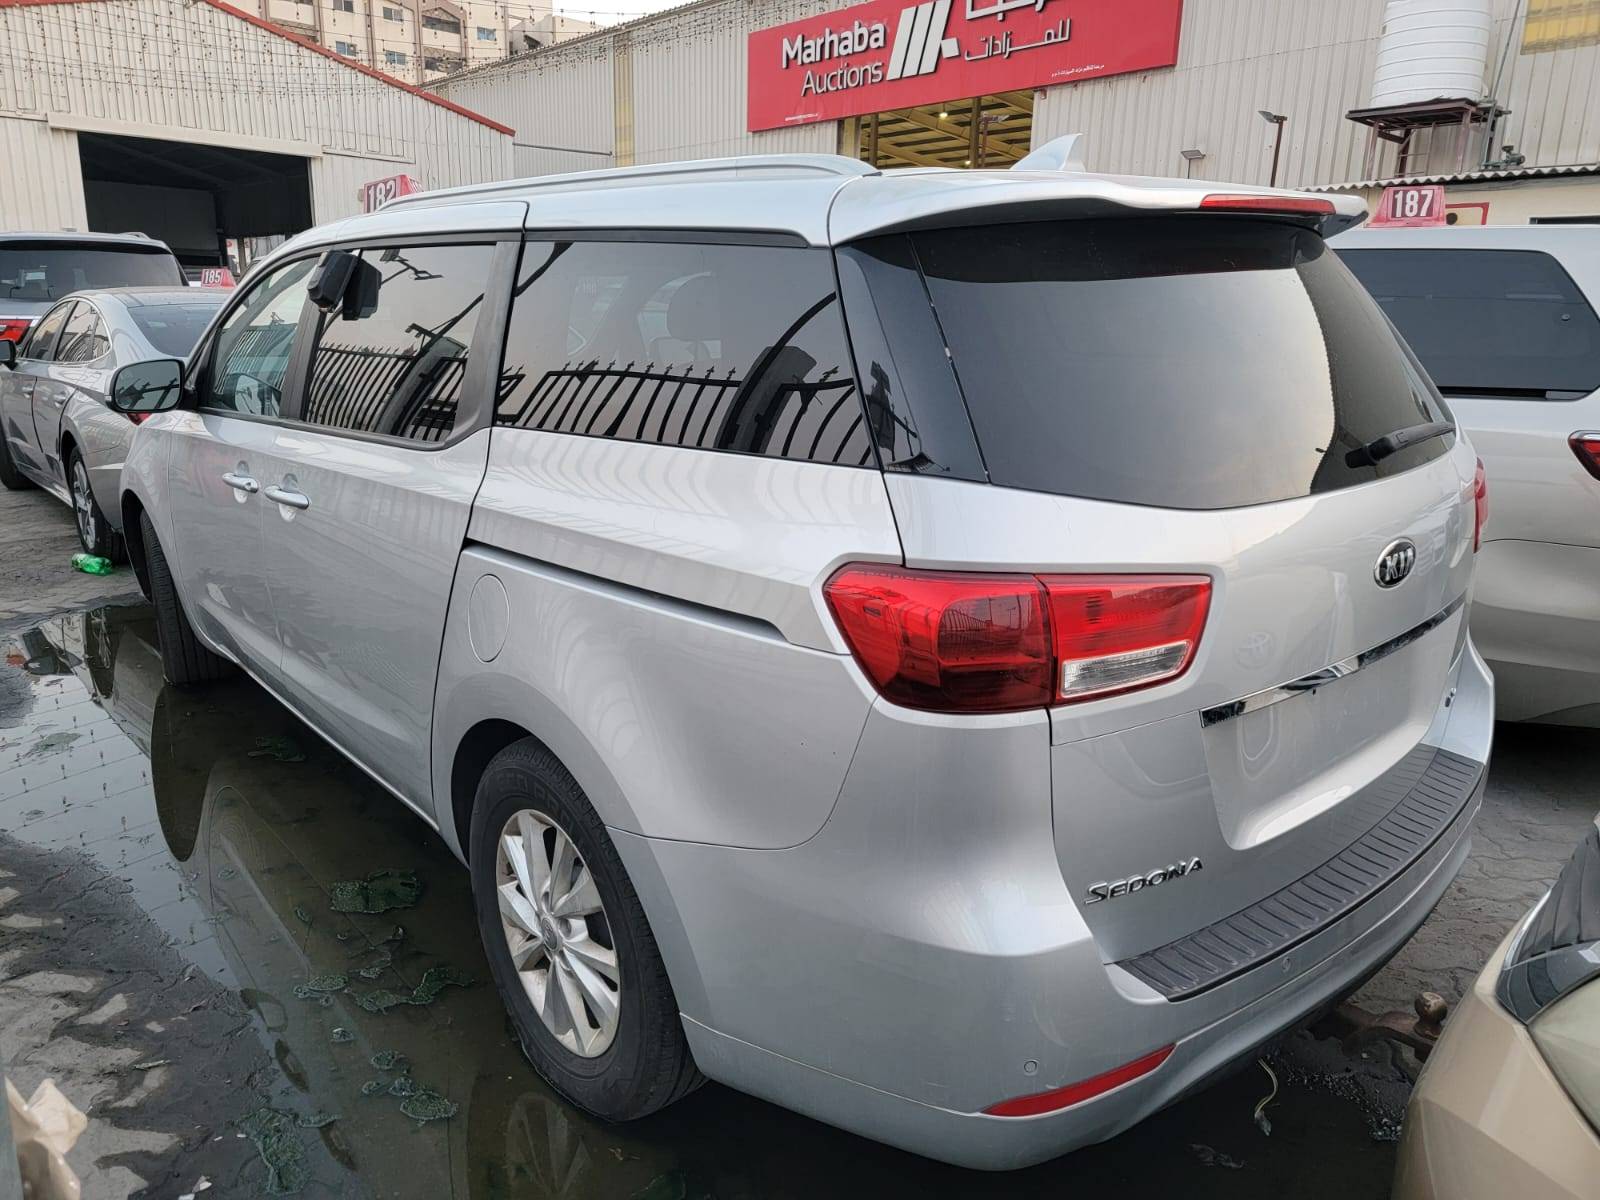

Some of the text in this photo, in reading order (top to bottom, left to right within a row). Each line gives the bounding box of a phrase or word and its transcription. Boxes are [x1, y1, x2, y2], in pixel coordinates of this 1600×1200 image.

[782, 21, 885, 69] Marhaba
[801, 62, 884, 96] Auctions
[368, 180, 396, 212] 182
[1394, 189, 1434, 218] 187
[204, 269, 221, 284] 185
[1384, 548, 1413, 581] KIA
[1084, 857, 1203, 905] SEDONA
